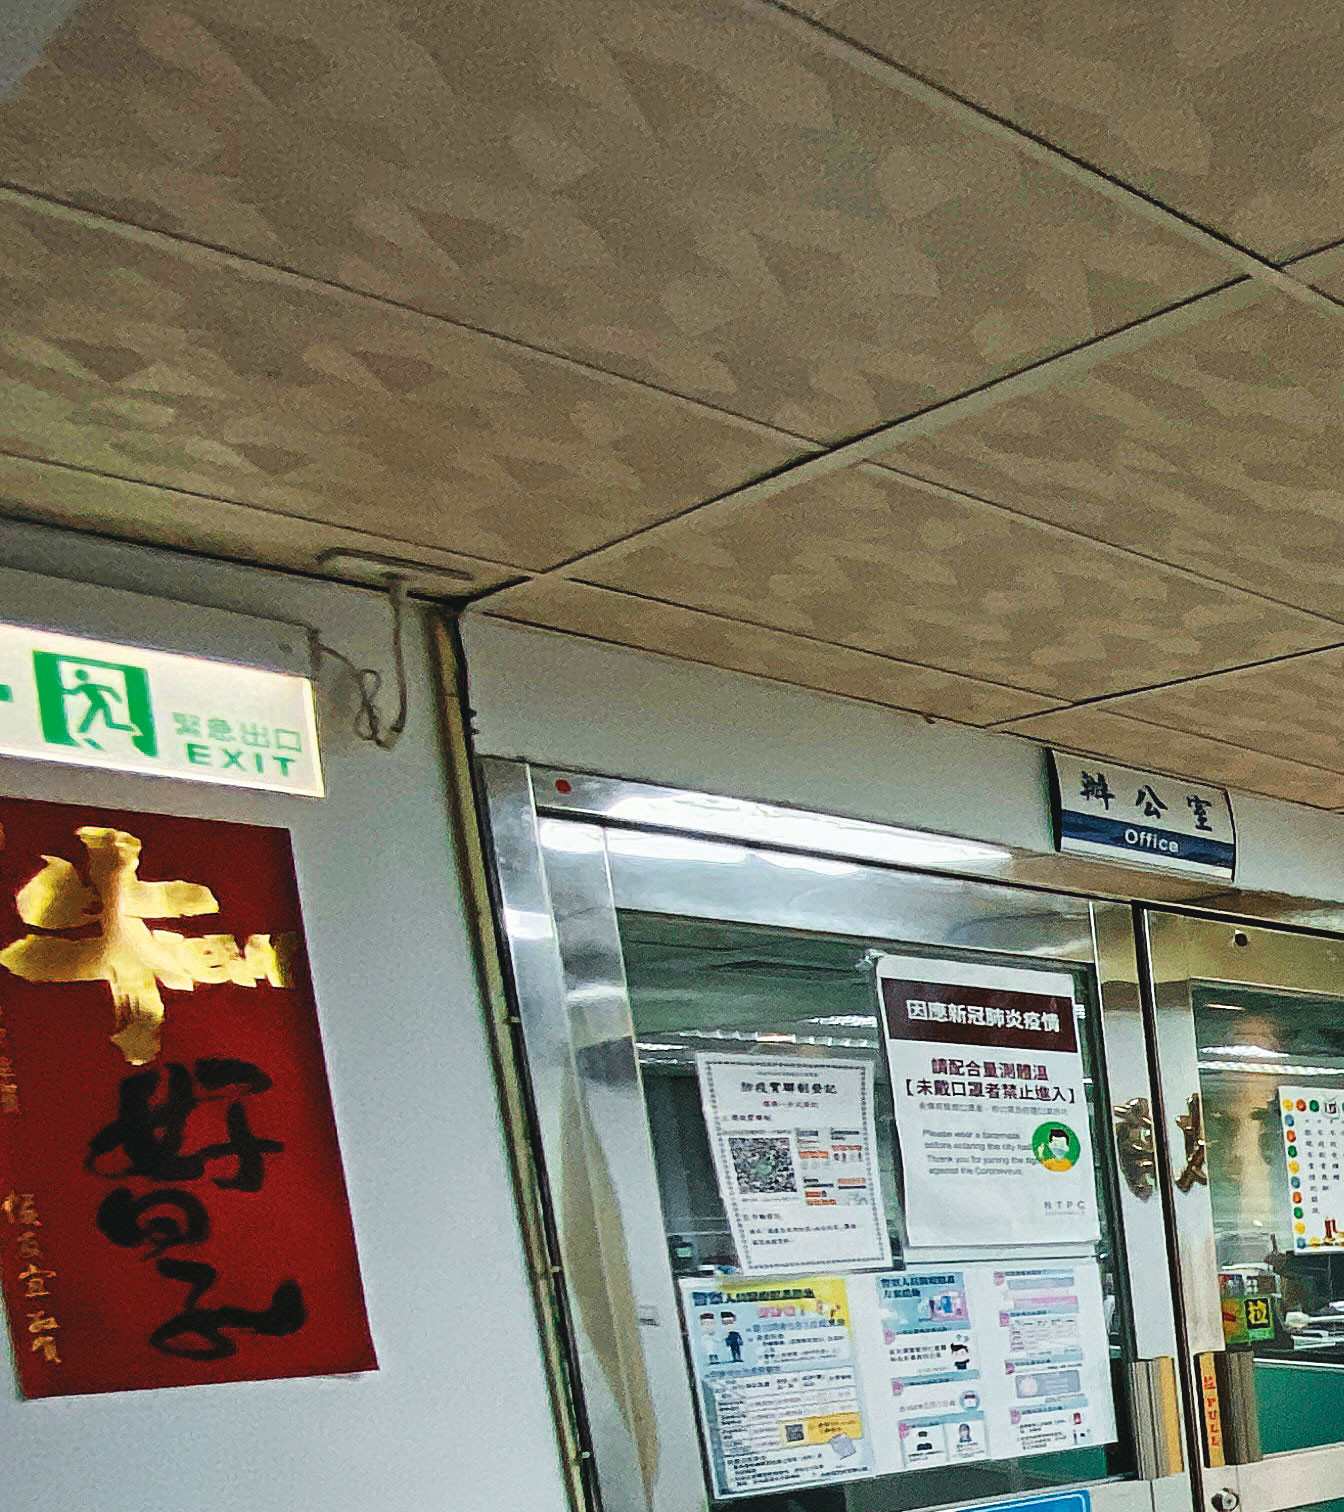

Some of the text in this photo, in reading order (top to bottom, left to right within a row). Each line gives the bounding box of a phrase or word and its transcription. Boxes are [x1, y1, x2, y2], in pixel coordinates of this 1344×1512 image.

[171, 711, 303, 753] 緊急出口
[186, 743, 296, 777] EXIT
[1124, 829, 1180, 853] Office
[906, 999, 1061, 1033] 因應新冠肺炎疫情
[931, 1057, 1049, 1081] 請配合量測體溫
[1206, 1397, 1221, 1447] PULL
